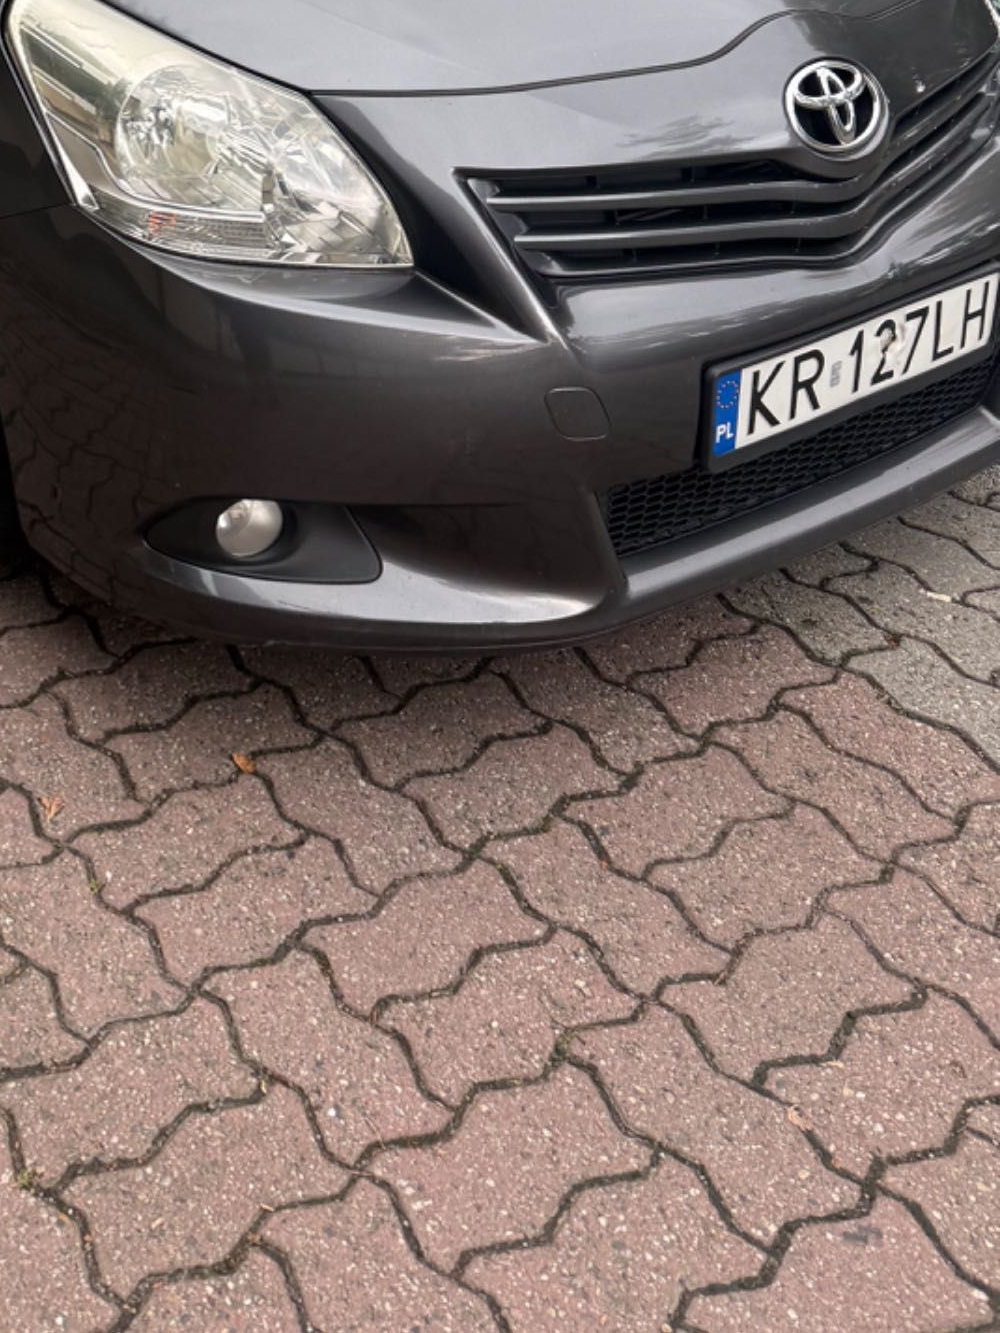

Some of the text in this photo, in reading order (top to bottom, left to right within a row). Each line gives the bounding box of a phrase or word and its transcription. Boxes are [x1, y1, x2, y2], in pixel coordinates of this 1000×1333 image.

[748, 281, 990, 435] KR 127LH
[715, 421, 734, 443] PL
